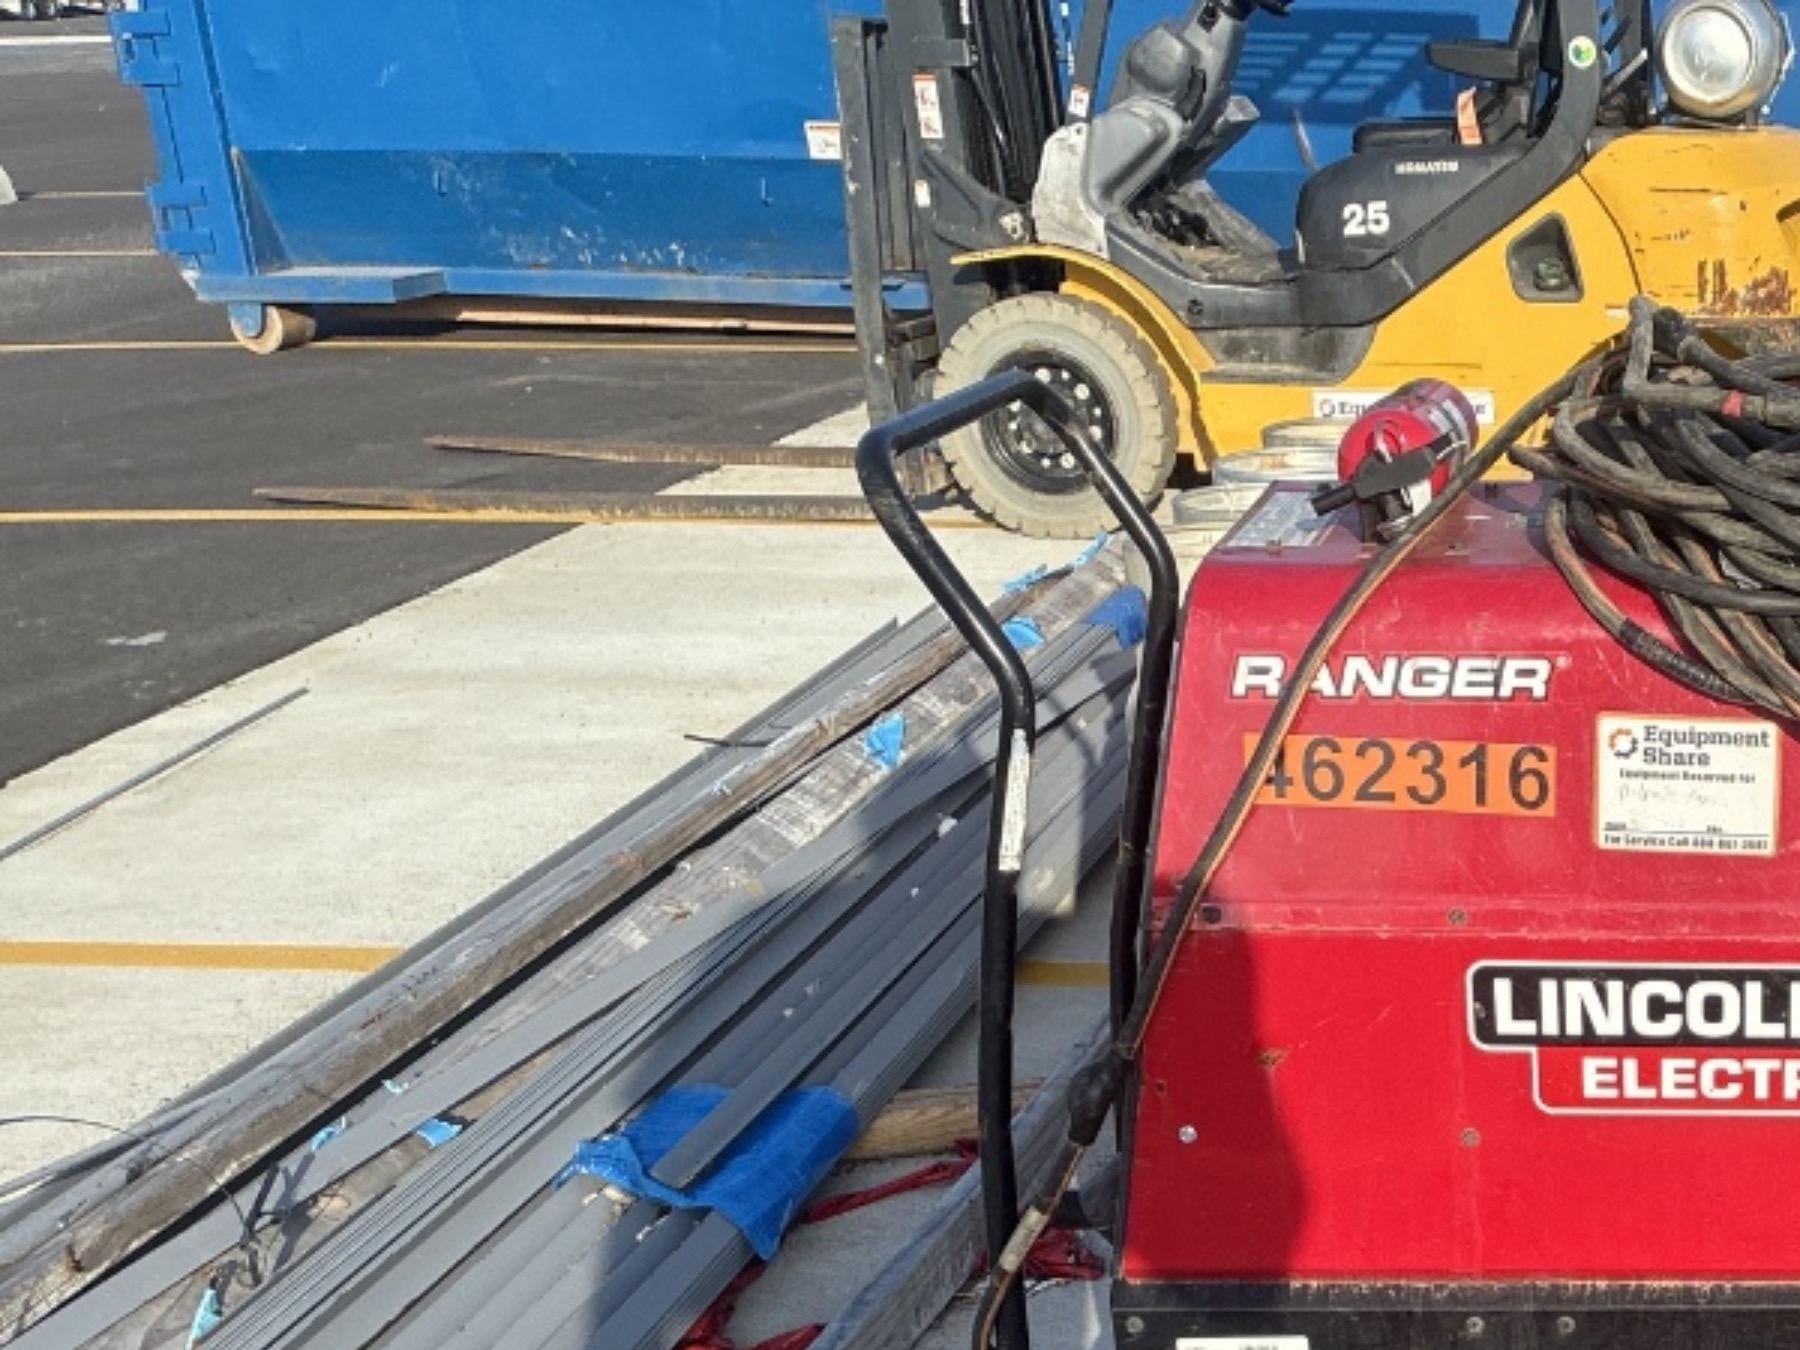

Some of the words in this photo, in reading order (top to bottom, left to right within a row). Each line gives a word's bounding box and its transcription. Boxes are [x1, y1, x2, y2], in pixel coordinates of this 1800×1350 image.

[1342, 199, 1391, 237] 25
[1643, 725, 1771, 748] Equipment
[1643, 746, 1711, 767] Share
[1262, 736, 1551, 811] 462316
